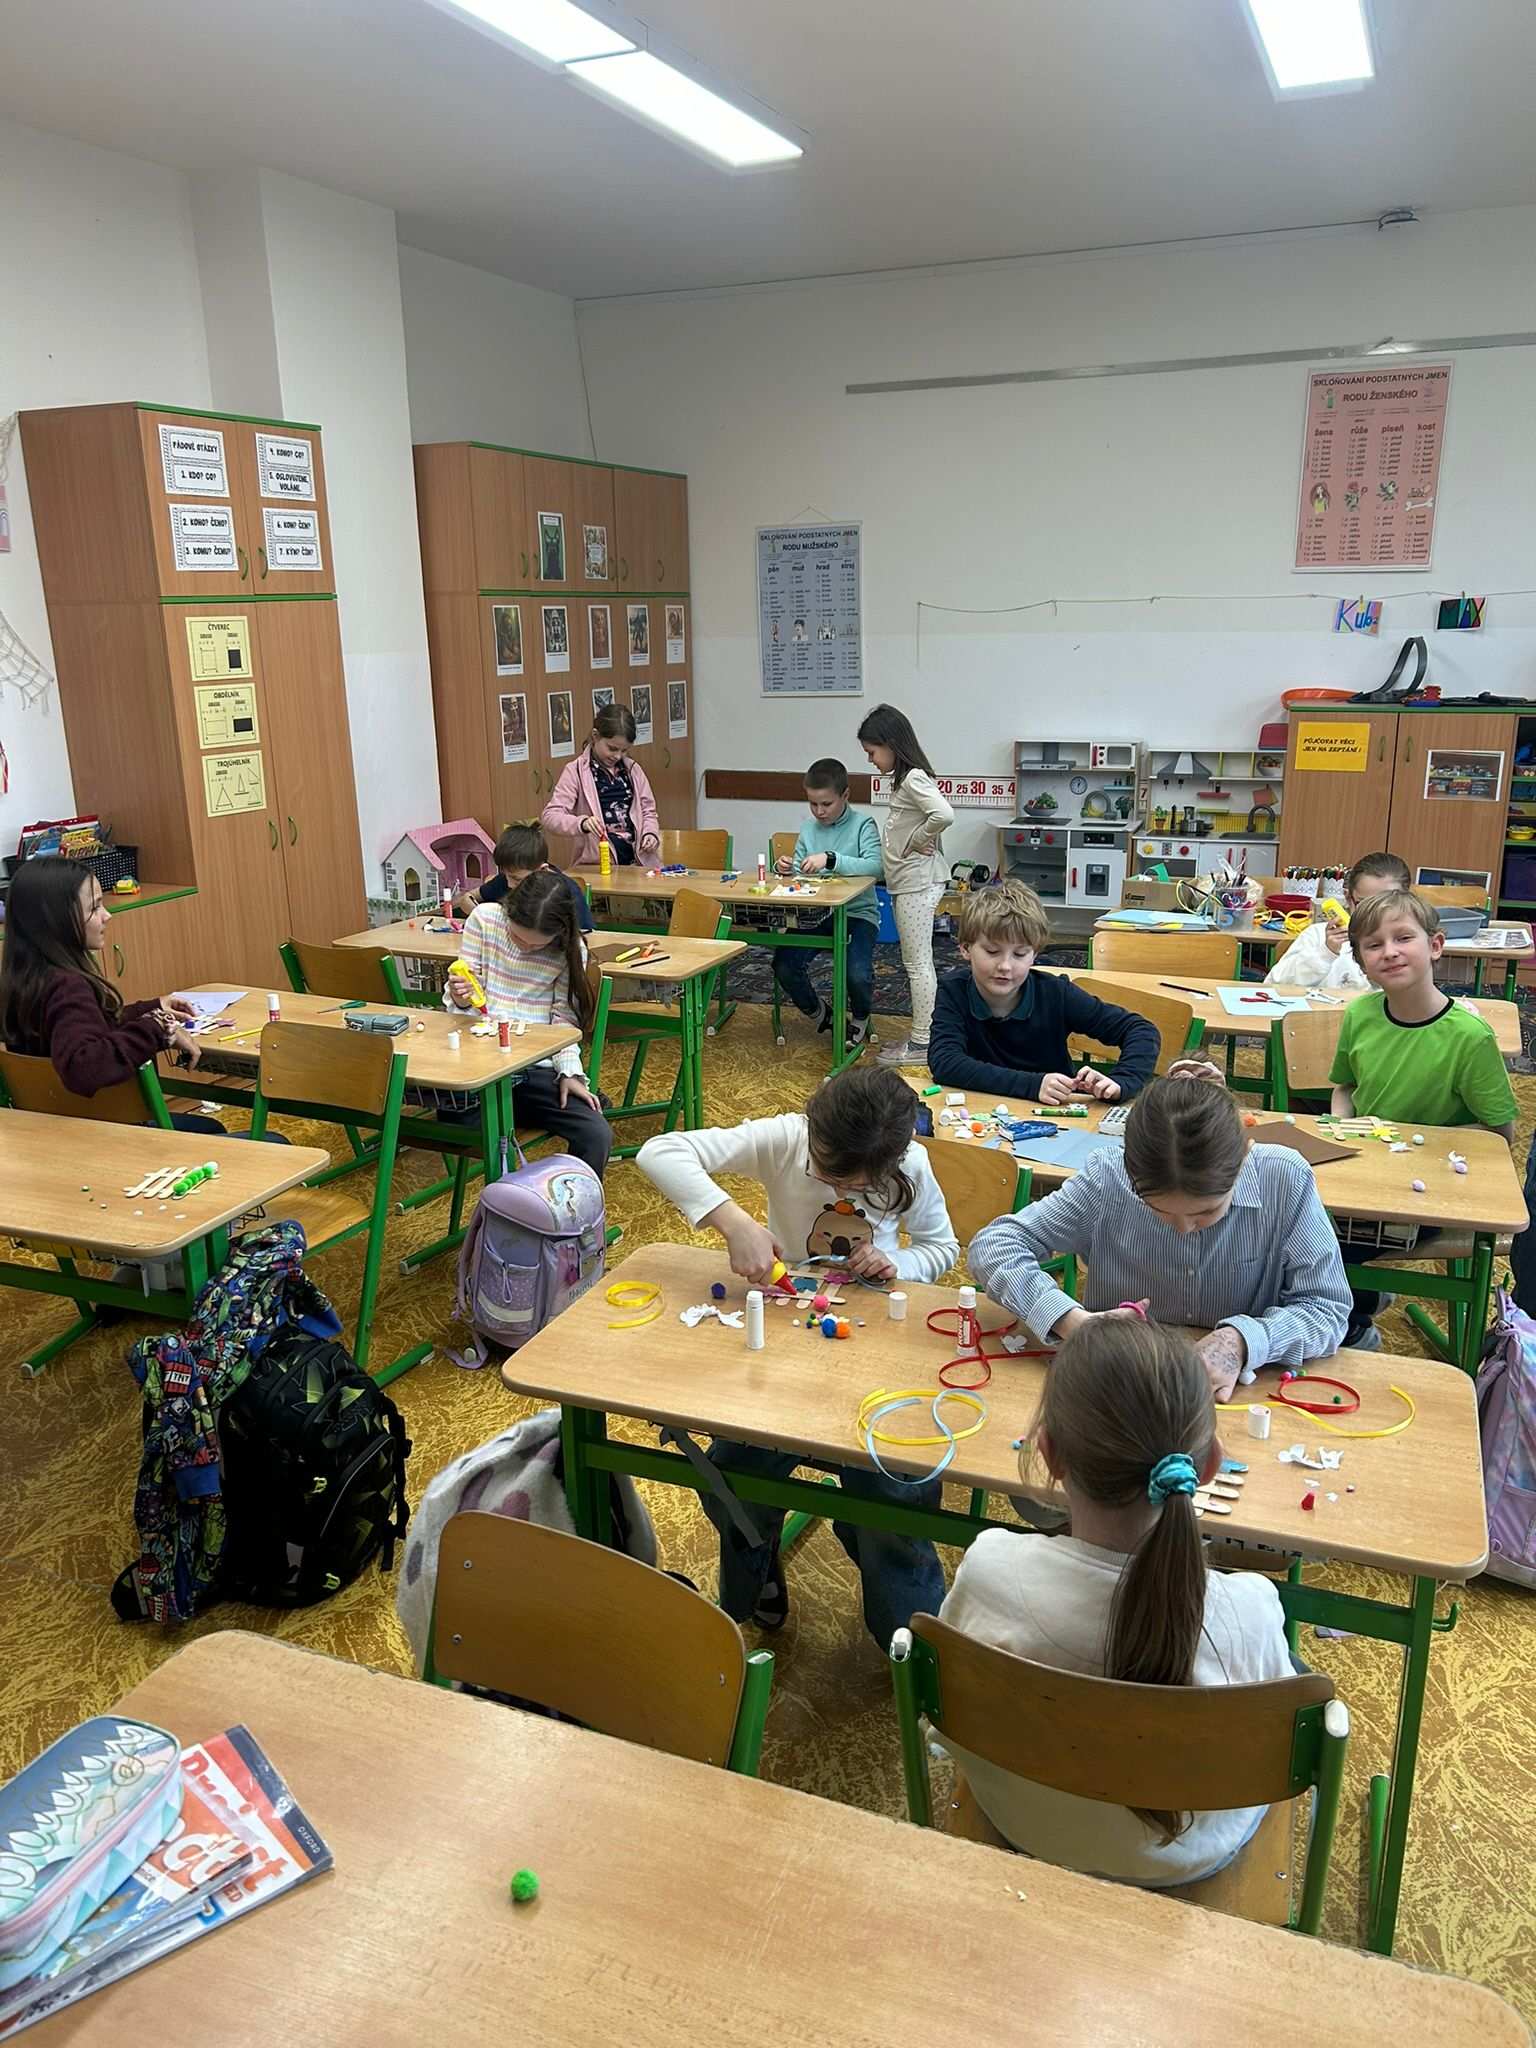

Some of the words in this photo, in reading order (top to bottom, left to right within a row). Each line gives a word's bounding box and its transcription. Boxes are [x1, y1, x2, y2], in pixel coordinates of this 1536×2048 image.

[1314, 376, 1365, 387] SKLOŇOVÁNÍ
[1366, 372, 1424, 384] PODSTATNÝCH
[1425, 371, 1448, 381] JMEN
[1343, 393, 1368, 402] RODU
[1369, 389, 1419, 401] ŽENSKÉHO
[1314, 427, 1334, 437] žena
[1350, 424, 1369, 435] růže
[173, 440, 196, 451] PÁDOVÉ
[197, 442, 217, 453] OTÁZKY
[276, 448, 294, 457] KOHO?
[294, 450, 304, 459] CO?
[189, 471, 204, 480] KDO?
[205, 472, 217, 481] CO?
[183, 517, 189, 527] 2.
[190, 517, 209, 527] KOHO?
[210, 516, 228, 528] ČEHO?
[798, 530, 841, 539] PODSTATNÝCH
[782, 543, 801, 551] RODU
[802, 540, 839, 550] MUŽSKÉHO
[1438, 597, 1486, 628] AX
[207, 622, 231, 631] ČTVEREC
[213, 690, 240, 699] OBDÉLNÍK
[1303, 737, 1338, 745] PŮJČOVAT
[1339, 737, 1355, 745] VĚCI
[216, 758, 251, 768] TROJÚHELNÍK
[872, 778, 881, 792] 0
[936, 780, 953, 794] 20
[956, 783, 968, 795] 25
[970, 781, 986, 795] 30
[992, 784, 1004, 795] 35
[172, 1372, 190, 1385] TNT
[297, 1825, 321, 1855] OXFORD
